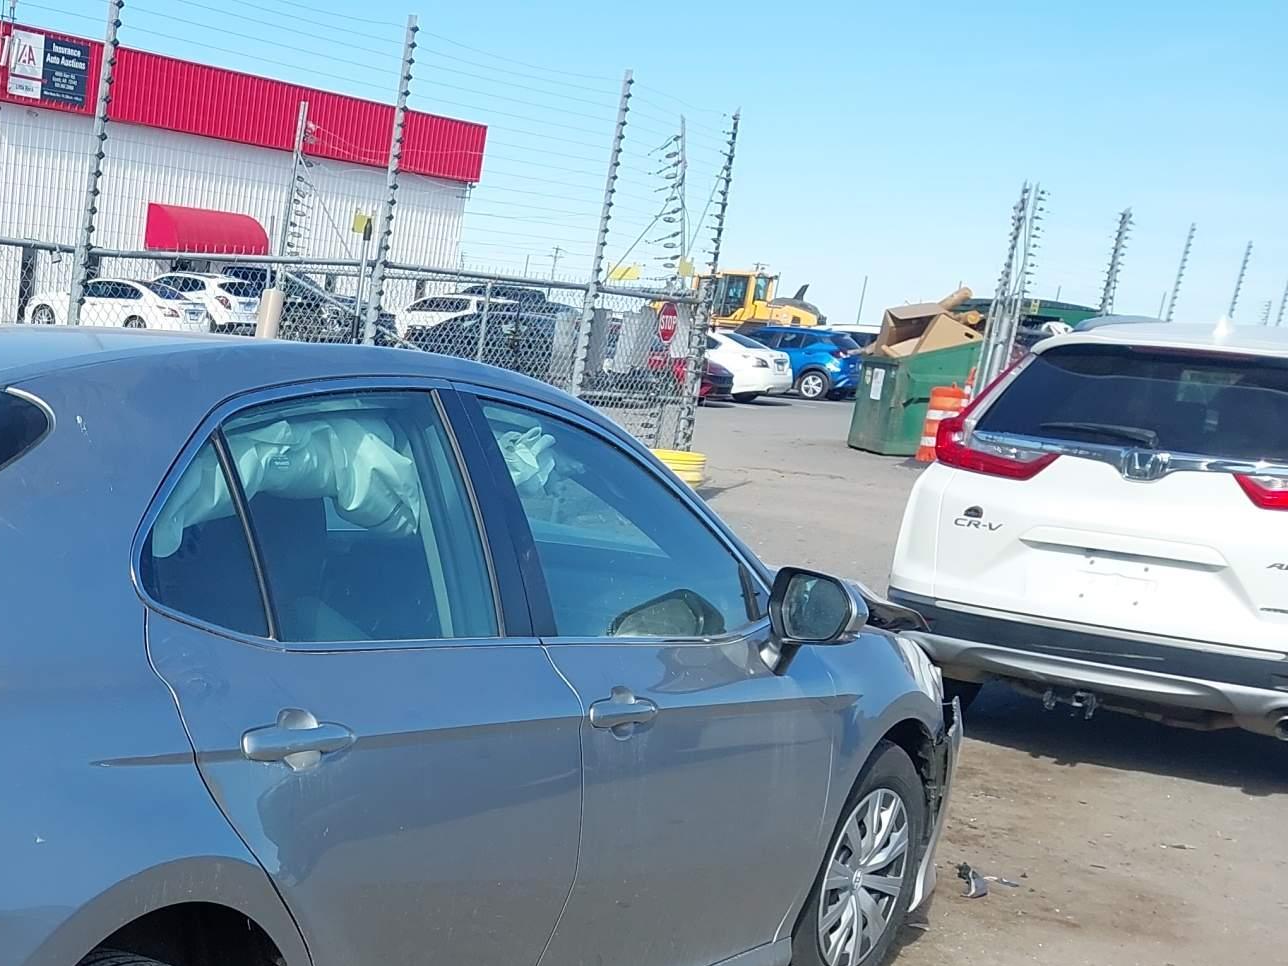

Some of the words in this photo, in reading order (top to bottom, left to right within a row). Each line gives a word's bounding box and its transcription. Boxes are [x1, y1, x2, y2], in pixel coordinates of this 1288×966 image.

[52, 42, 81, 57] Insurance
[46, 53, 60, 64] Auto
[60, 55, 86, 70] Auctions
[660, 315, 677, 331] STOP
[954, 518, 1004, 531] CR-V
